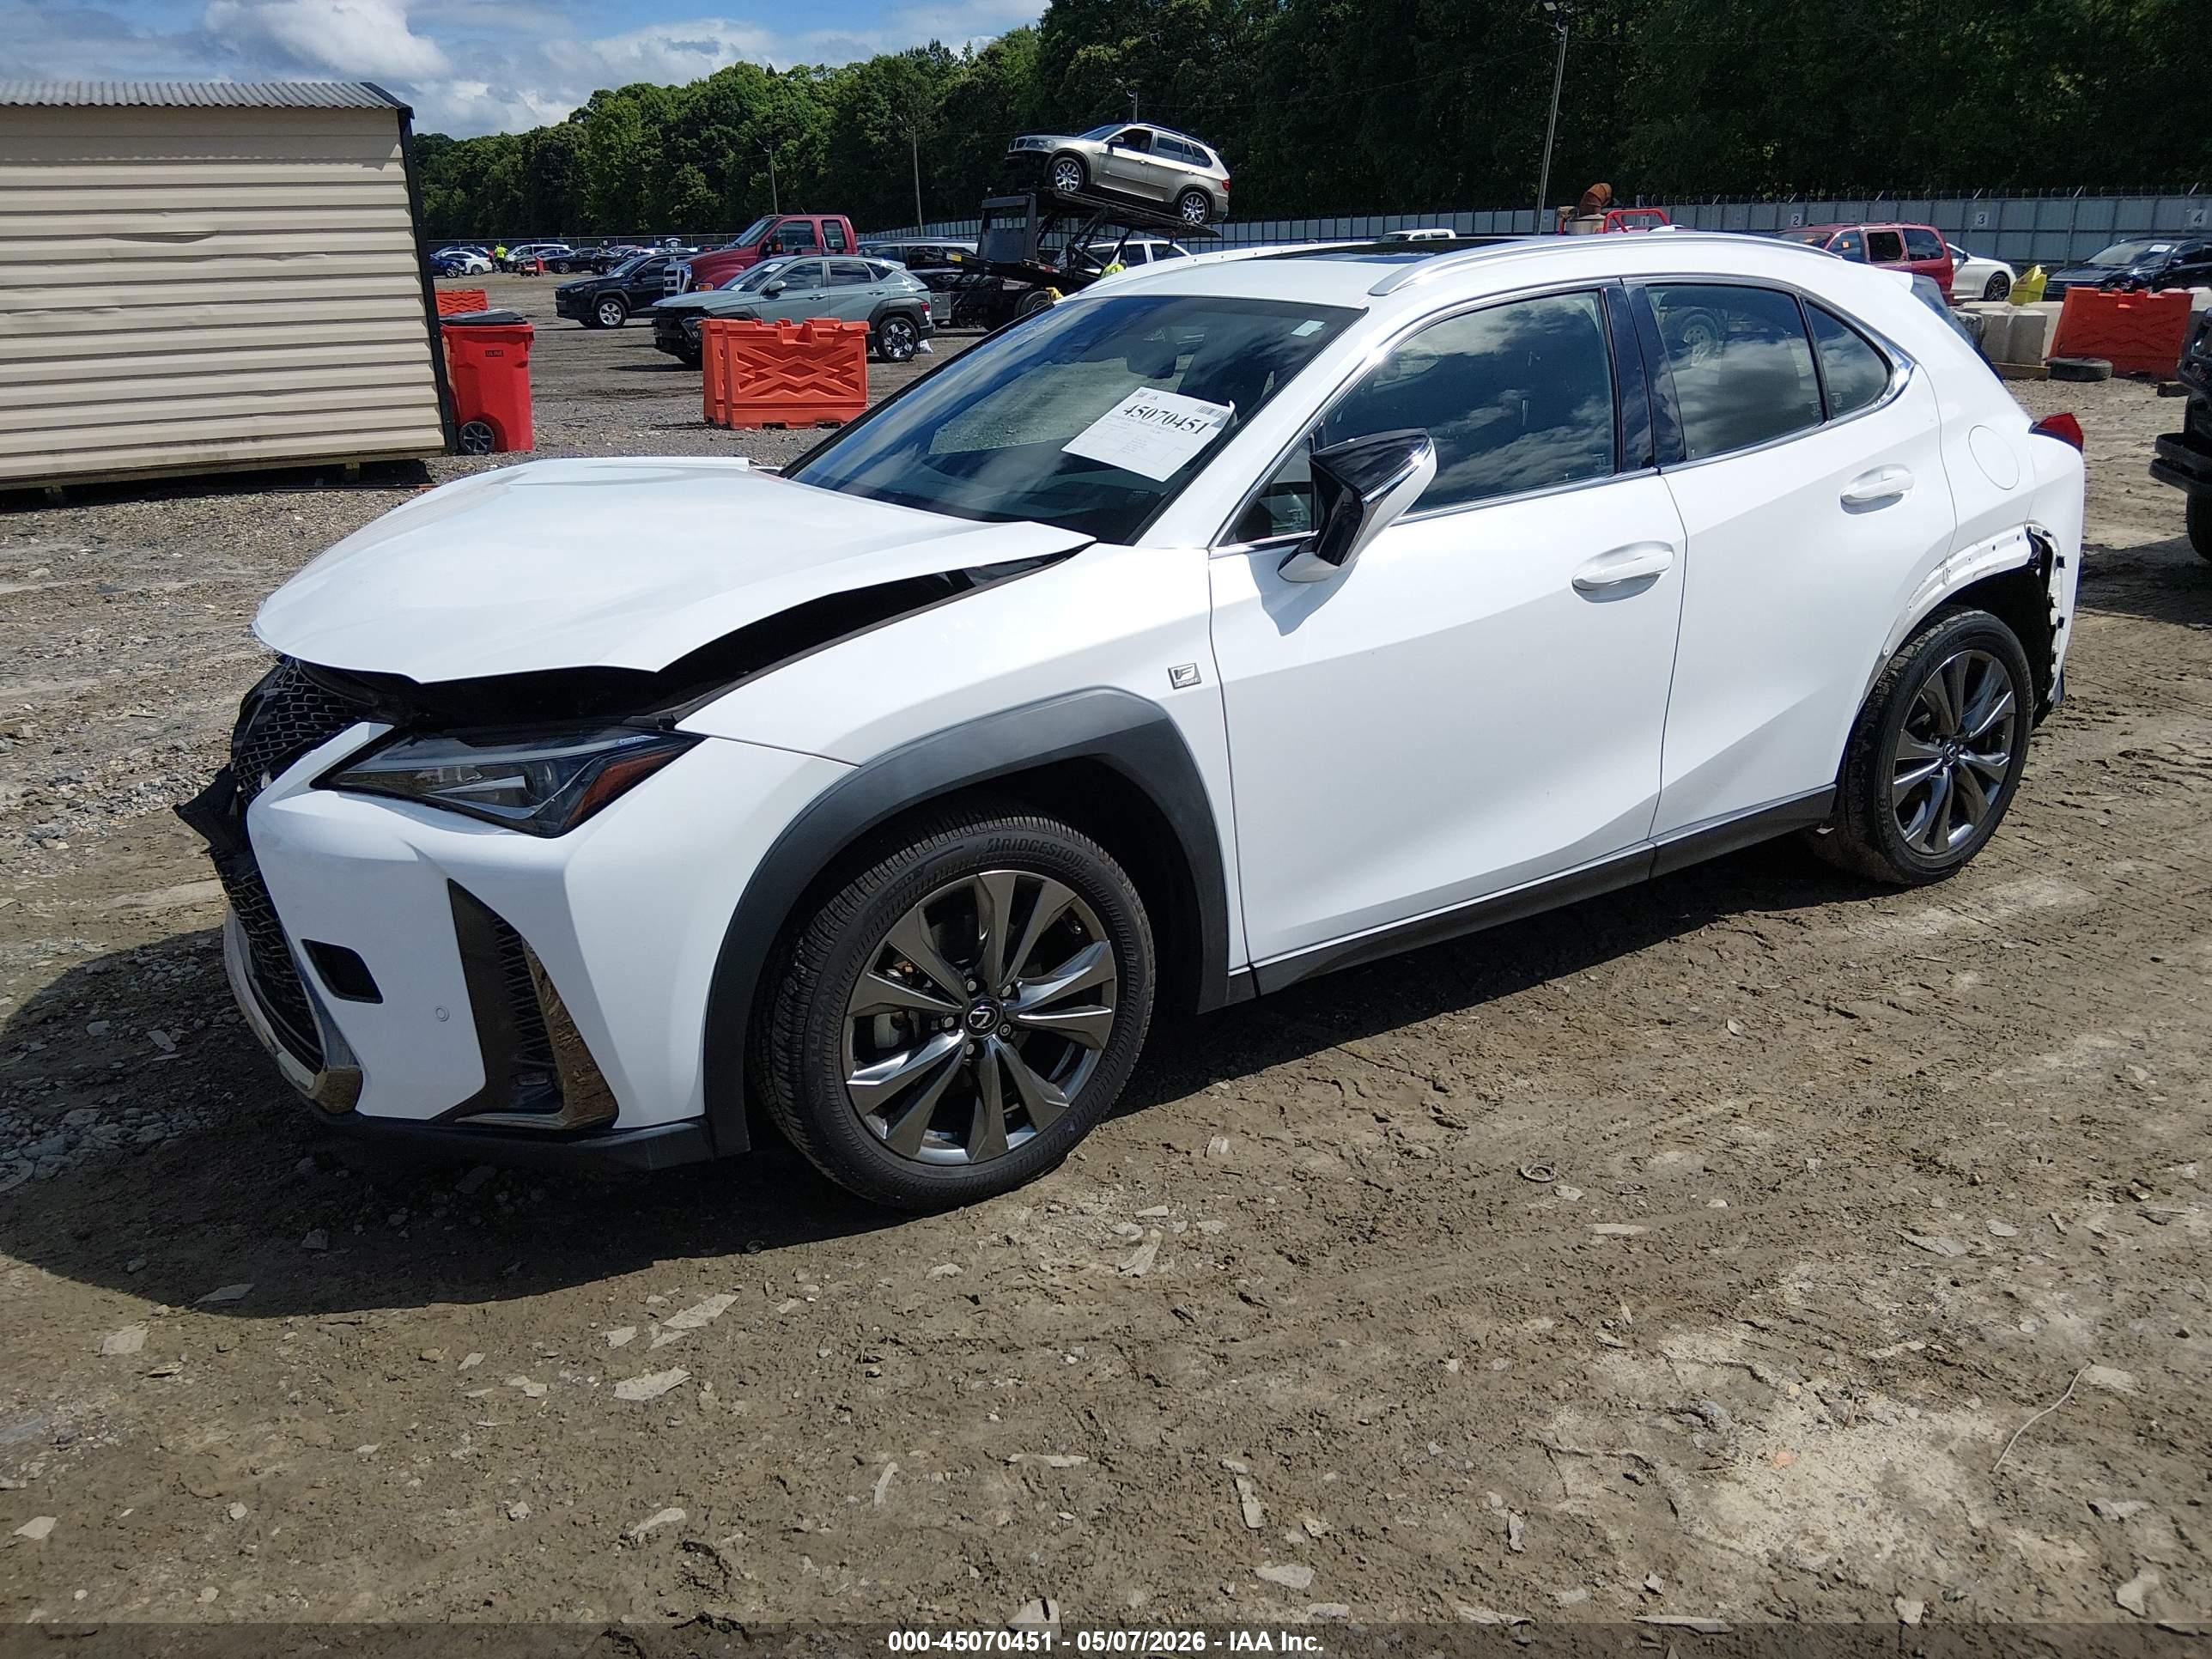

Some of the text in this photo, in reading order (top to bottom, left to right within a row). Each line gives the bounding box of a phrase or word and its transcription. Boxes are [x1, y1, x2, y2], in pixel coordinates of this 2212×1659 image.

[1792, 215, 1800, 226] 2
[1978, 214, 1985, 224] 3
[1122, 404, 1210, 434] 45070451
[984, 837, 1091, 871] BRIDGESTONE
